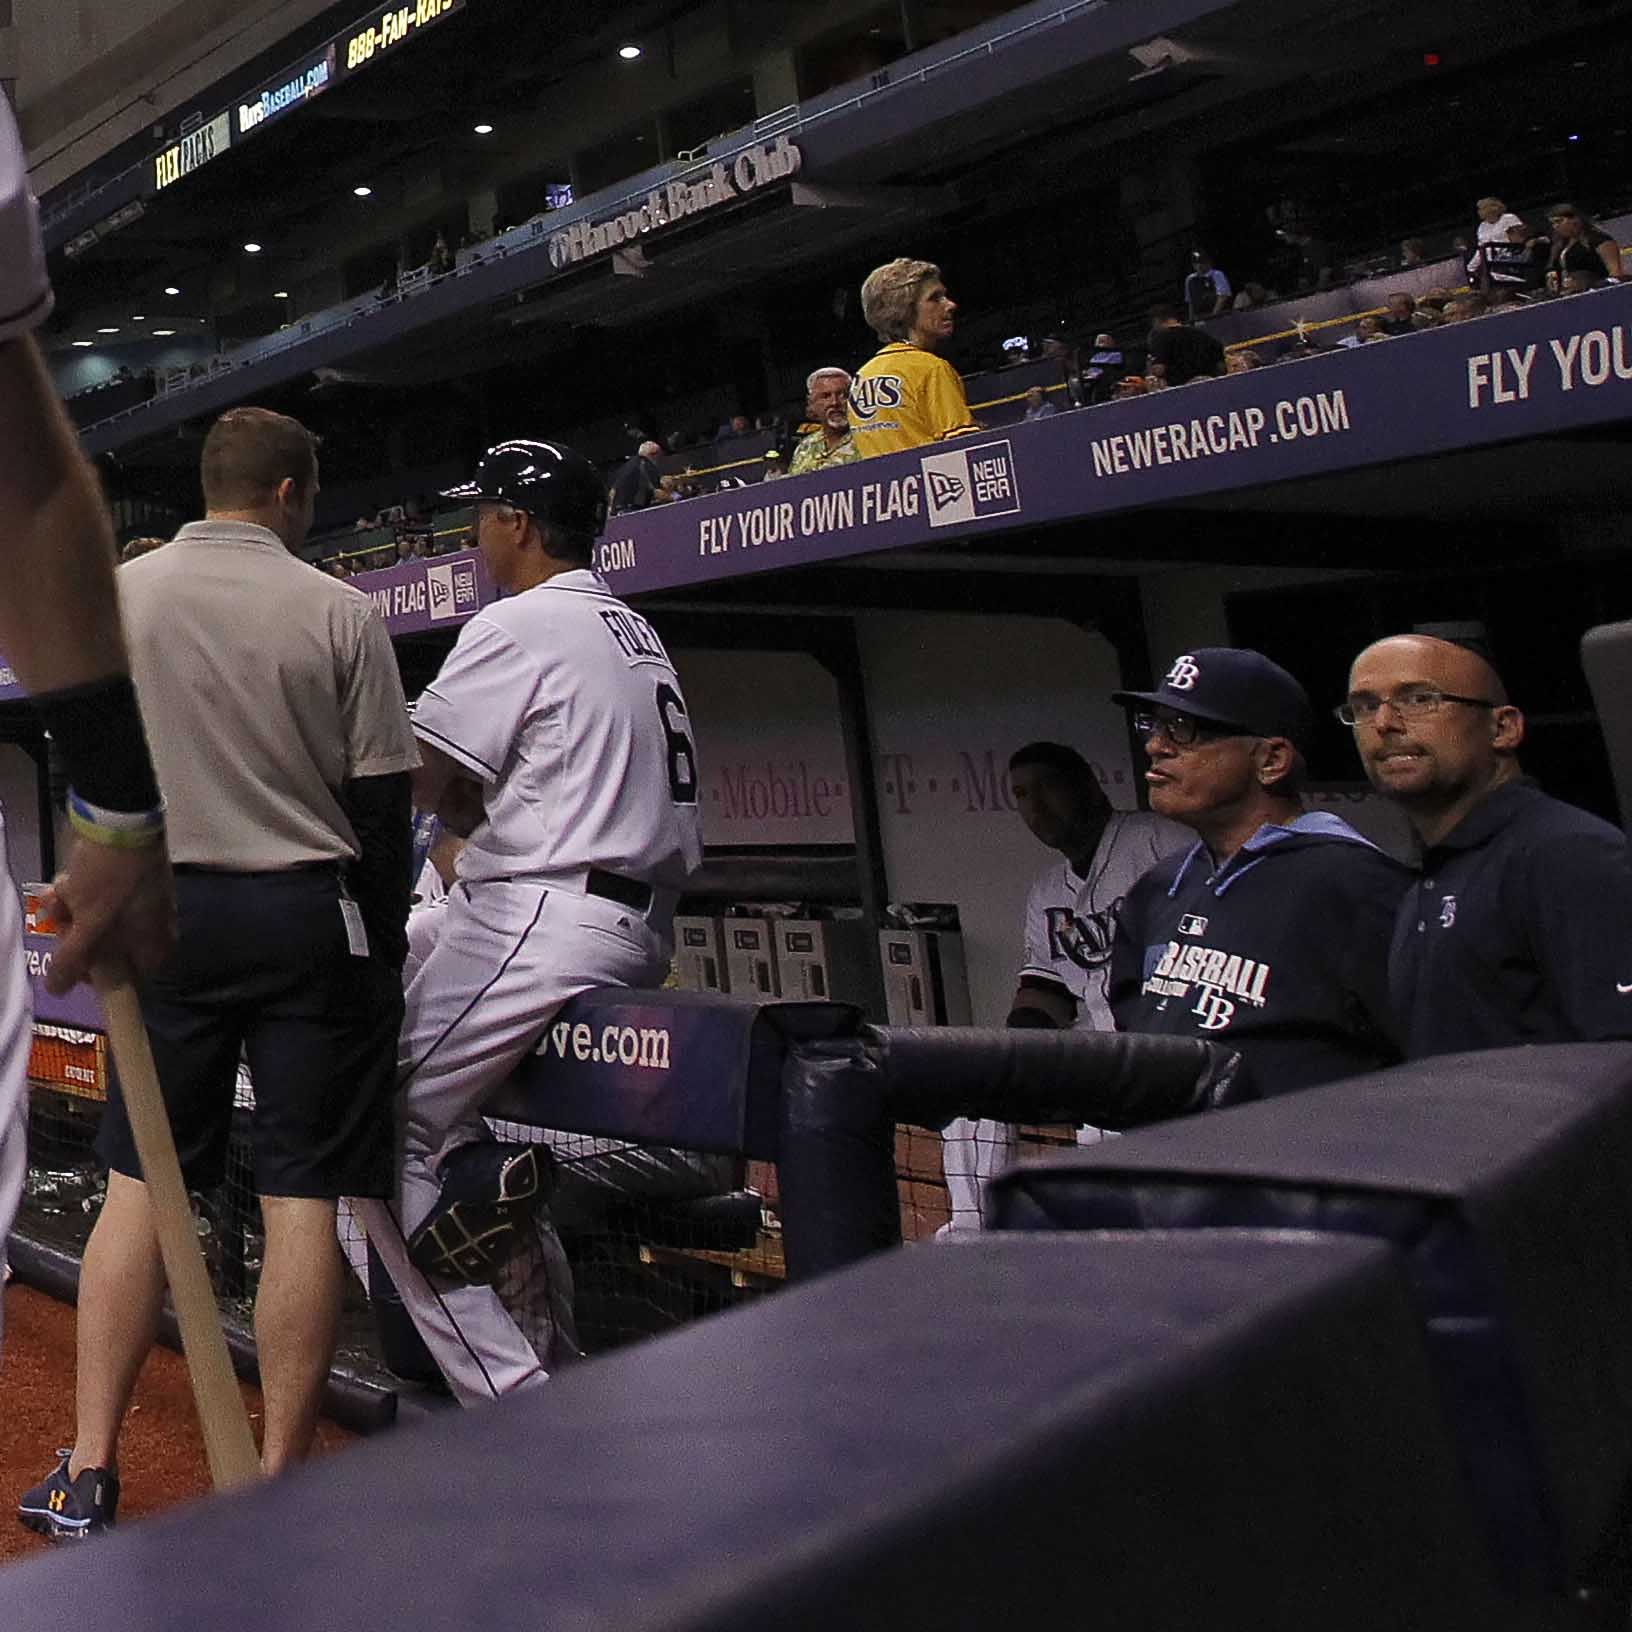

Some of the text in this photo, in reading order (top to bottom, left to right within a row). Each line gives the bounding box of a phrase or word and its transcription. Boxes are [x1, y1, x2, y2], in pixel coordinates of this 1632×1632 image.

[156, 145, 180, 191] FLEX
[666, 162, 737, 220] Bank
[735, 134, 801, 192] Club
[1468, 343, 1537, 409] FLY
[1090, 389, 1351, 478] NEWERACAP.COM
[972, 456, 1007, 481] NEW
[975, 478, 1011, 503] ERA
[698, 474, 919, 556] FLY YOUR OWN FLAG
[394, 578, 427, 616] FLAG
[655, 680, 698, 805] 6
